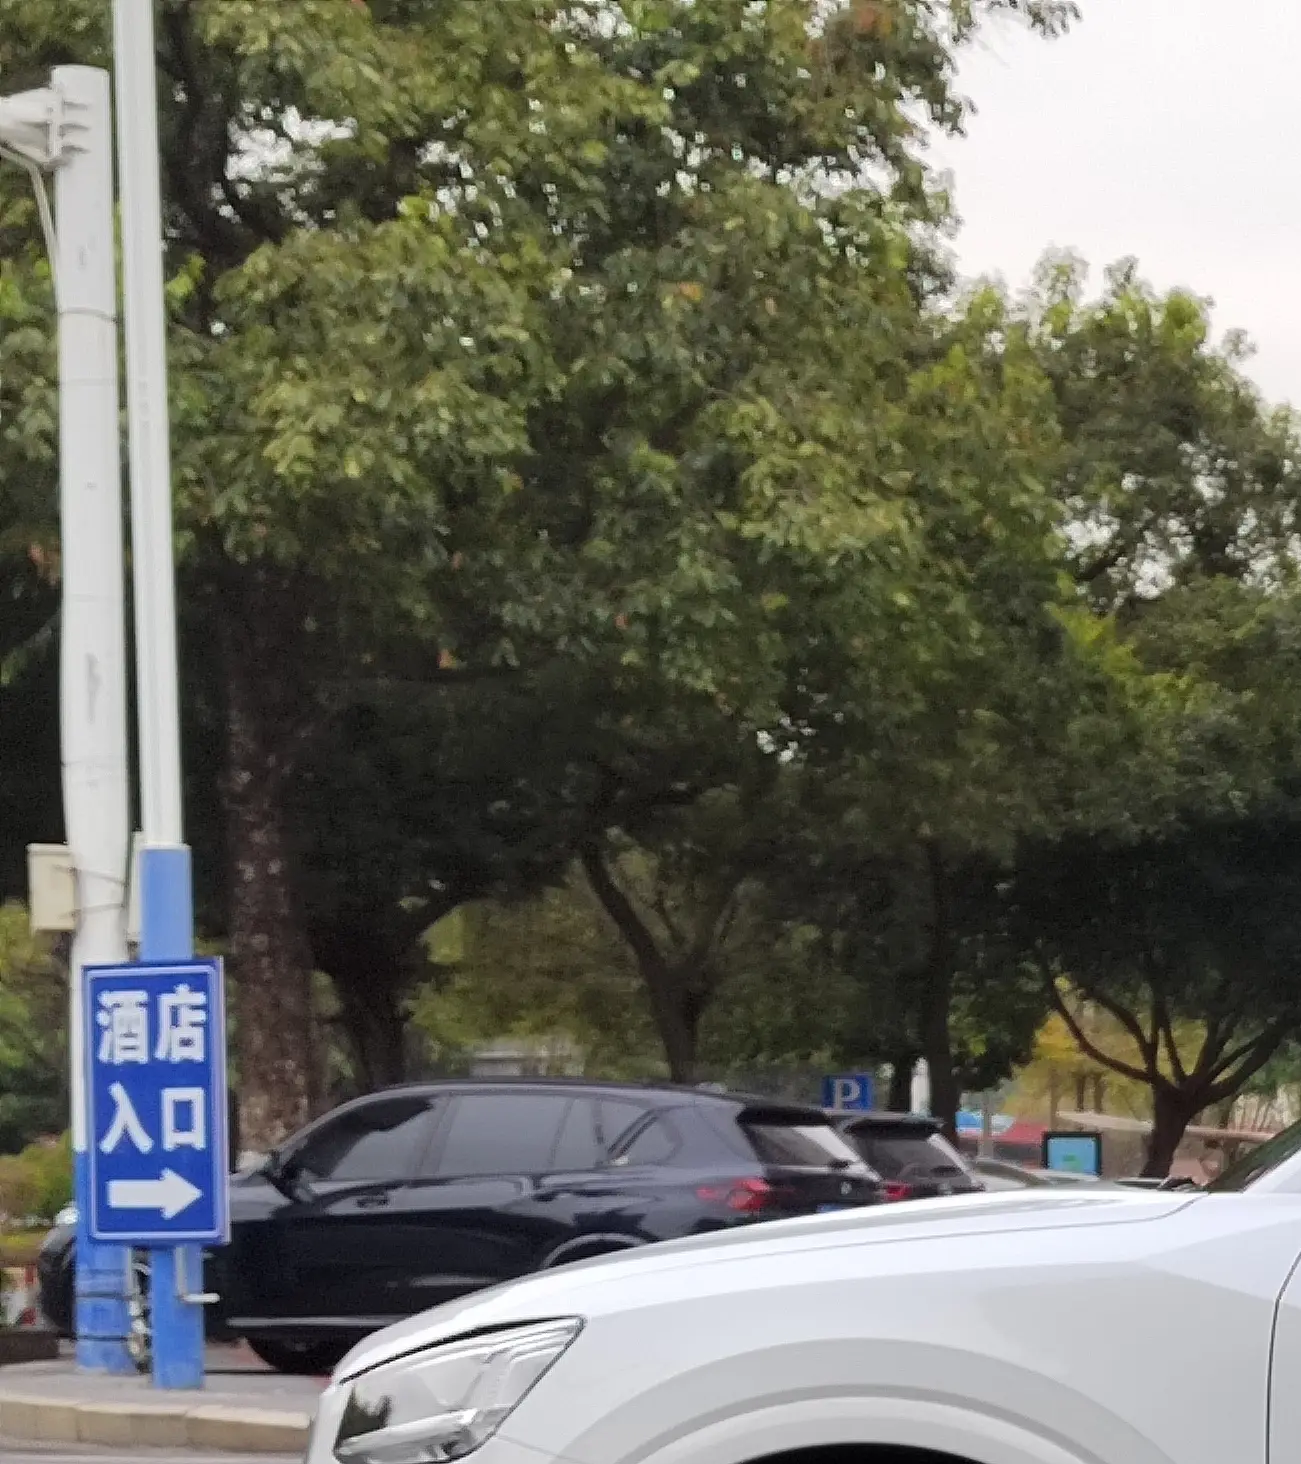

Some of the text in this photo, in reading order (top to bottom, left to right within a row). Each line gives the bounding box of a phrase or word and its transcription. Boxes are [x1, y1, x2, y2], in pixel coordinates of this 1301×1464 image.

[97, 983, 207, 1064] 酒店
[100, 1081, 206, 1153] 入口
[834, 1079, 860, 1110] P
